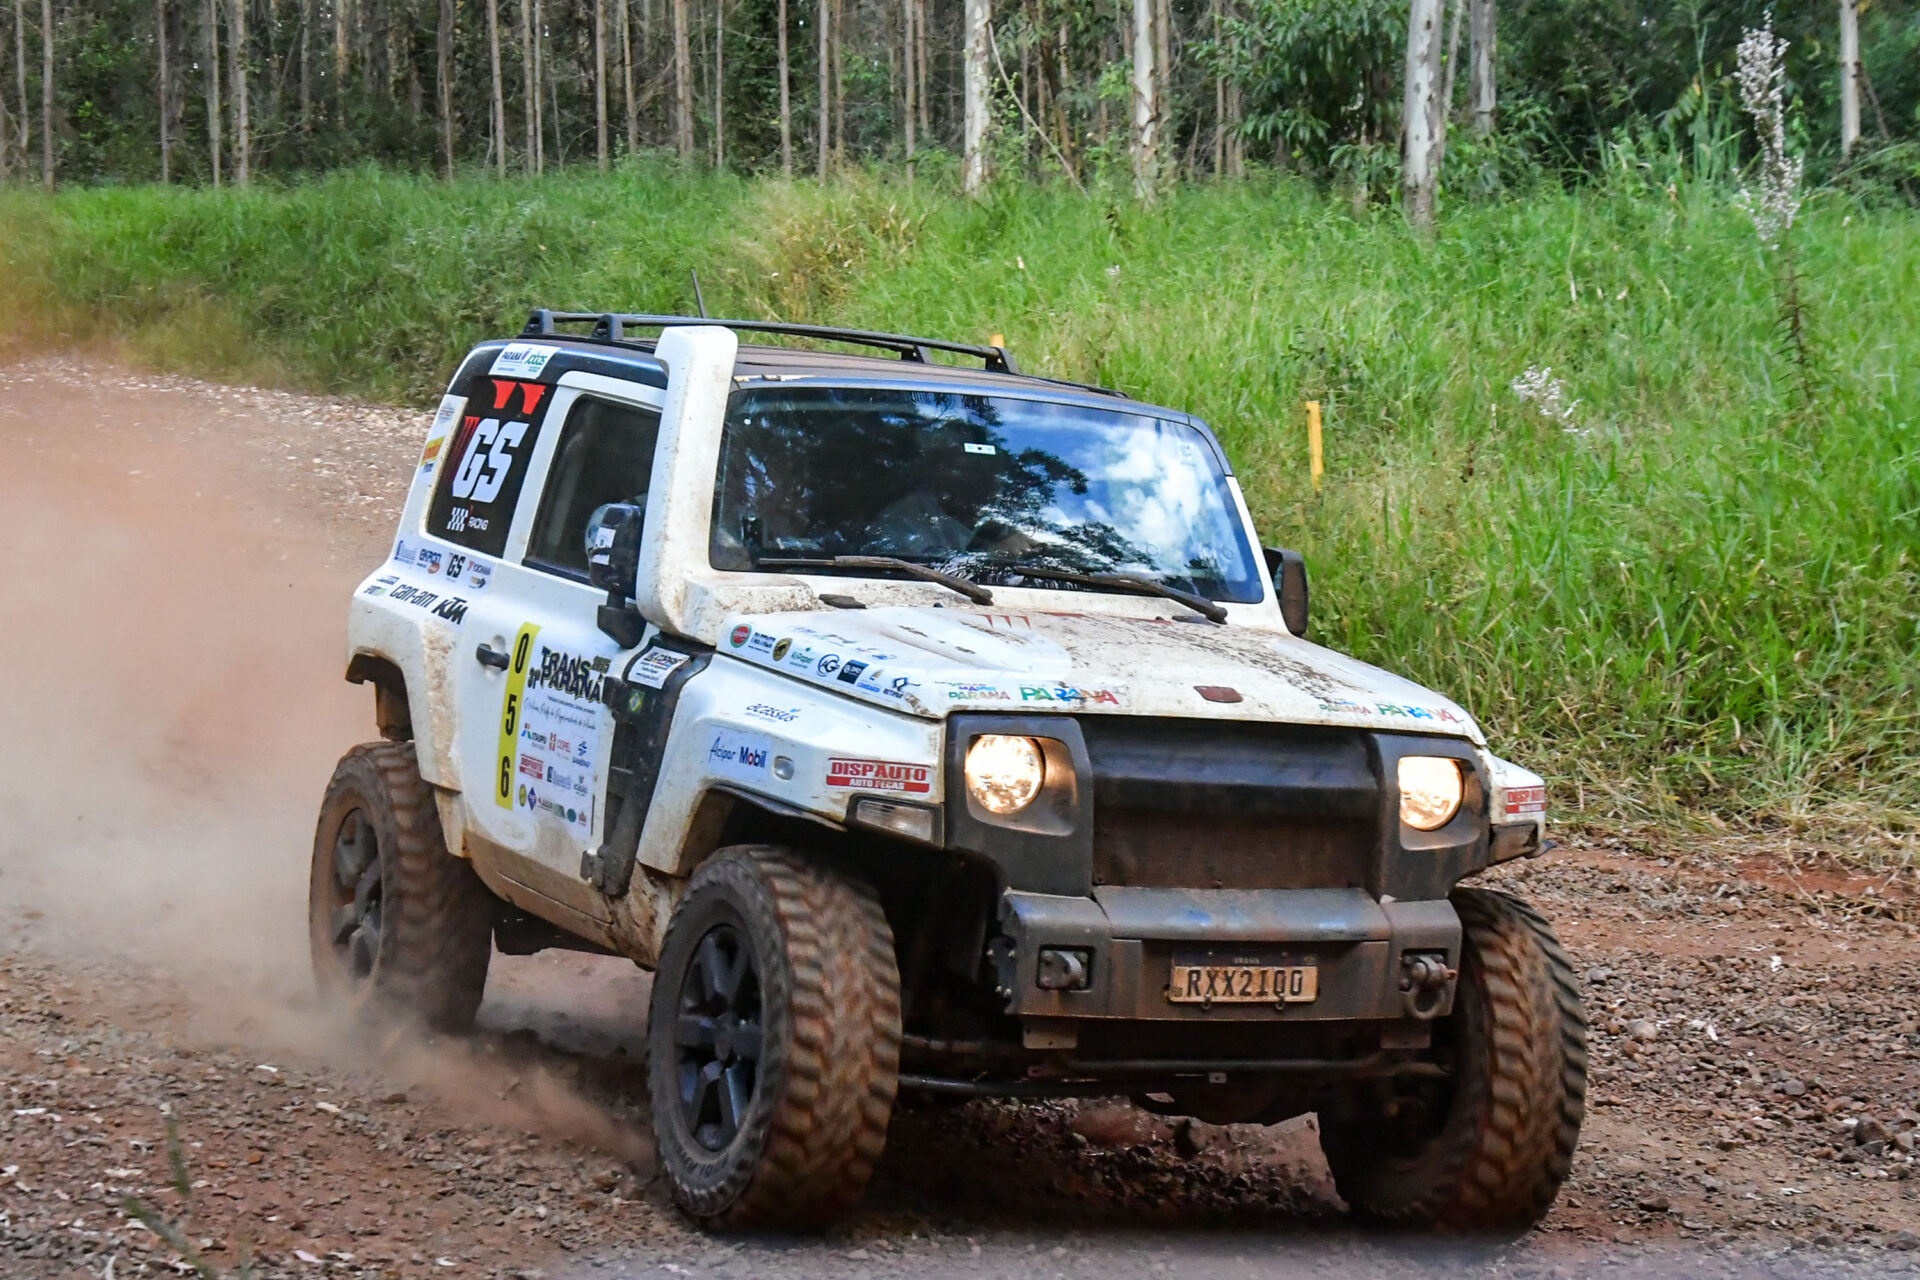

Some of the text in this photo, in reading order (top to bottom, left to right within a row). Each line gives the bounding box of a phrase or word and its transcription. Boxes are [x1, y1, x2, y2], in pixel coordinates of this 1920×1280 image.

[452, 417, 529, 504] GS
[467, 516, 490, 531] RACING
[446, 554, 466, 579] GS
[388, 584, 440, 608] can-am
[431, 596, 469, 626] KTM
[541, 646, 592, 678] TRANS
[738, 745, 768, 769] Mobil
[831, 762, 928, 782] DISPAUTO
[848, 778, 874, 788] AUTO
